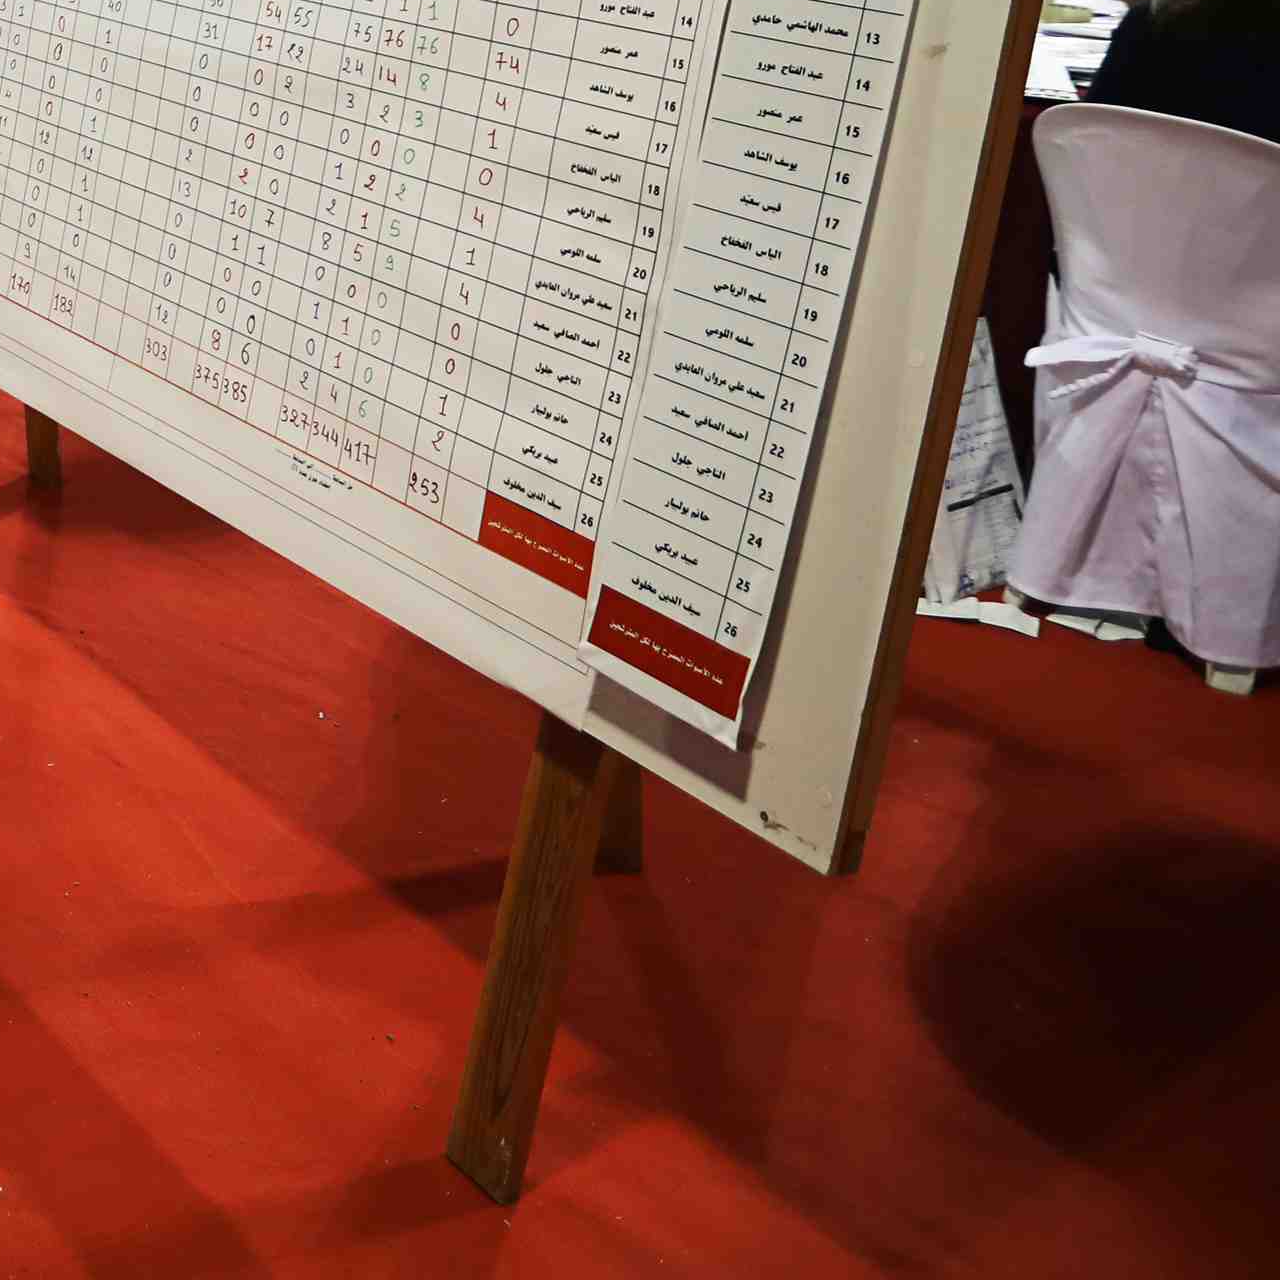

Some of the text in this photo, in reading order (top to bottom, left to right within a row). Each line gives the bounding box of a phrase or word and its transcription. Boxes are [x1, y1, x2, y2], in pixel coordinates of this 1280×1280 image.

[506, 17, 520, 36] 0
[752, 14, 880, 44] 13 محمد الهاشمي حامدي
[496, 51, 520, 74] 74
[756, 61, 870, 92] 14 عبد الفتاح مورو
[495, 92, 507, 111] 4
[757, 108, 860, 138] 15 عمر منصور
[487, 128, 498, 150] 1
[478, 167, 493, 186] 0
[744, 150, 850, 184] 16 يوسف الشاهد
[762, 202, 782, 213] قيس
[473, 206, 484, 229] 4
[825, 217, 840, 230] 17
[720, 236, 752, 252] الفخفاخ
[464, 247, 476, 266] 1
[814, 263, 829, 276] 18
[459, 282, 470, 305] 4
[713, 283, 818, 322] 19 سليم الرياحي
[450, 322, 461, 341] 0
[705, 327, 733, 340] اللومي
[145, 338, 168, 361] 303
[444, 358, 456, 375] 0
[792, 353, 806, 367] 20
[195, 364, 220, 390] 375
[704, 373, 727, 387] مروان
[223, 378, 248, 403] 385
[746, 388, 765, 400] سعيد
[438, 393, 448, 417] 1
[671, 406, 691, 418] سعيد
[780, 398, 795, 412] 21
[312, 420, 338, 447] 344
[694, 417, 725, 432] الصافي
[344, 436, 377, 466] 417
[769, 443, 785, 458] 22
[671, 452, 774, 504] 23 الناجي جلول
[408, 472, 440, 504] 253
[690, 509, 710, 521] حاتم
[746, 533, 762, 548] 24
[654, 542, 751, 593] 25 عبيد بريكي
[632, 577, 737, 637] 26 سيف الدين مخلوف
